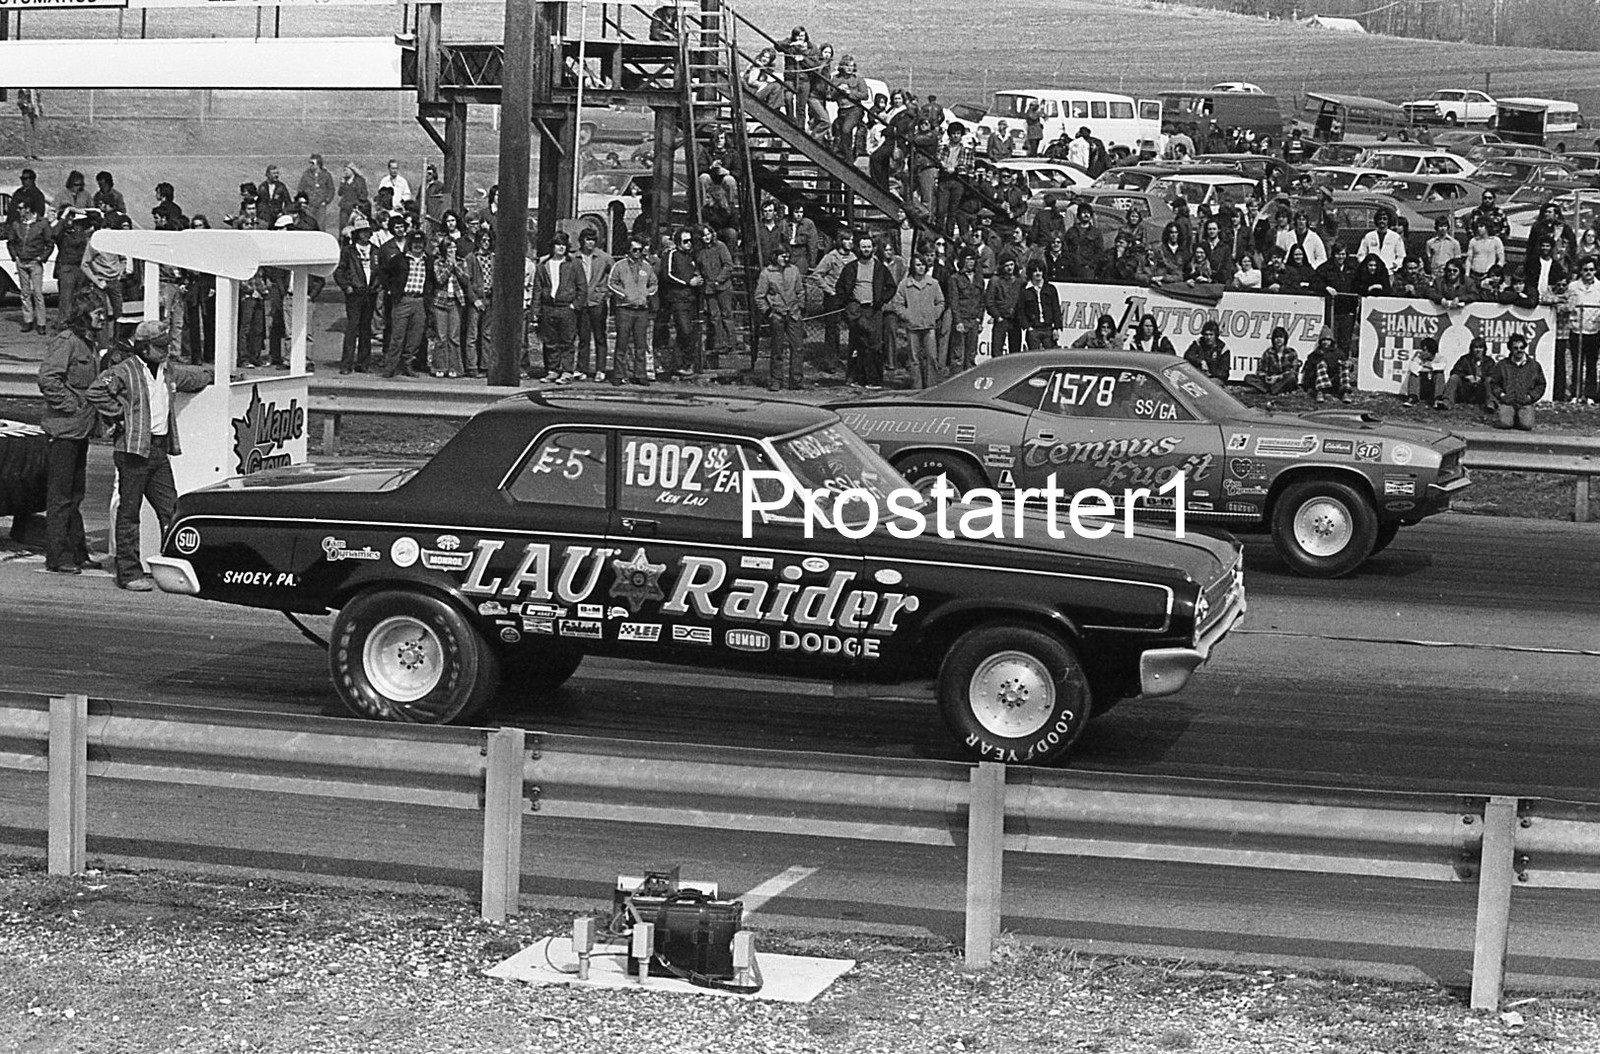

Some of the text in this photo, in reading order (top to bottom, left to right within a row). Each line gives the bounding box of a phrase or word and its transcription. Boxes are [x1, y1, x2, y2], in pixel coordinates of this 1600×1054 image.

[1117, 296, 1322, 342] AUTOMOTIVE
[1387, 314, 1439, 333] HANK'S
[1485, 320, 1536, 339] HANK'S
[1051, 372, 1116, 407] 1578
[1135, 400, 1177, 420] SS/GA
[256, 398, 304, 448] Maple
[843, 412, 955, 437] Plymouth
[1024, 436, 1184, 467] Tempus
[1359, 444, 1379, 457] STP
[532, 446, 591, 480] E-5
[624, 441, 703, 491] 1902
[179, 532, 197, 547] SW
[322, 537, 346, 549] Cam
[327, 547, 380, 561] Dynamics
[429, 556, 463, 565] MONROE
[223, 570, 297, 587] SHOEY, PA.
[459, 539, 920, 634] LAU Raider
[634, 625, 660, 636] LEE
[729, 633, 766, 648] GUMOUT
[779, 630, 880, 658] DODGE
